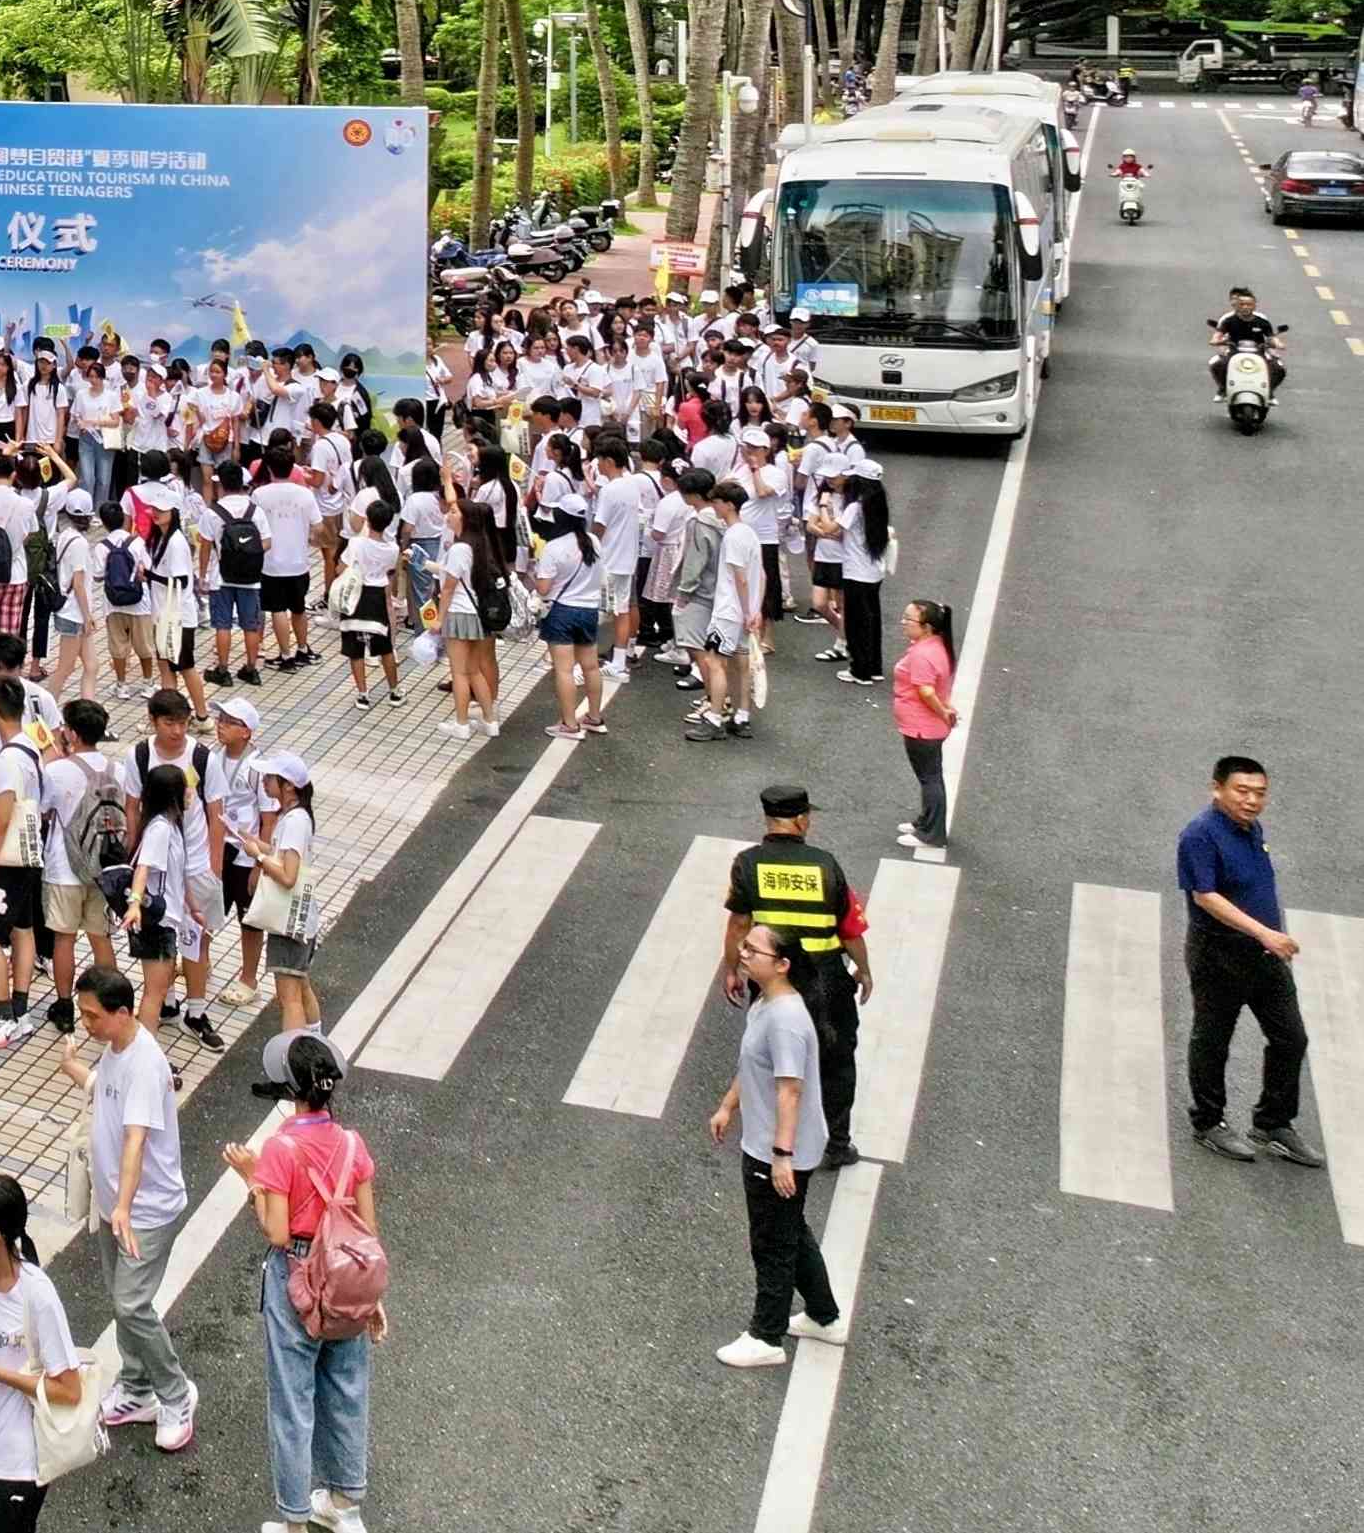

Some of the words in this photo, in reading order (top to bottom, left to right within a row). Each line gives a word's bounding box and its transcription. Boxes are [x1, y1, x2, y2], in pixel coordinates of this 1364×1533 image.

[87, 171, 155, 185] TOURISM
[160, 173, 176, 186] IN
[181, 174, 230, 187] CHINA
[48, 184, 133, 198] TEENAGERS
[763, 870, 818, 893] 海师安保
